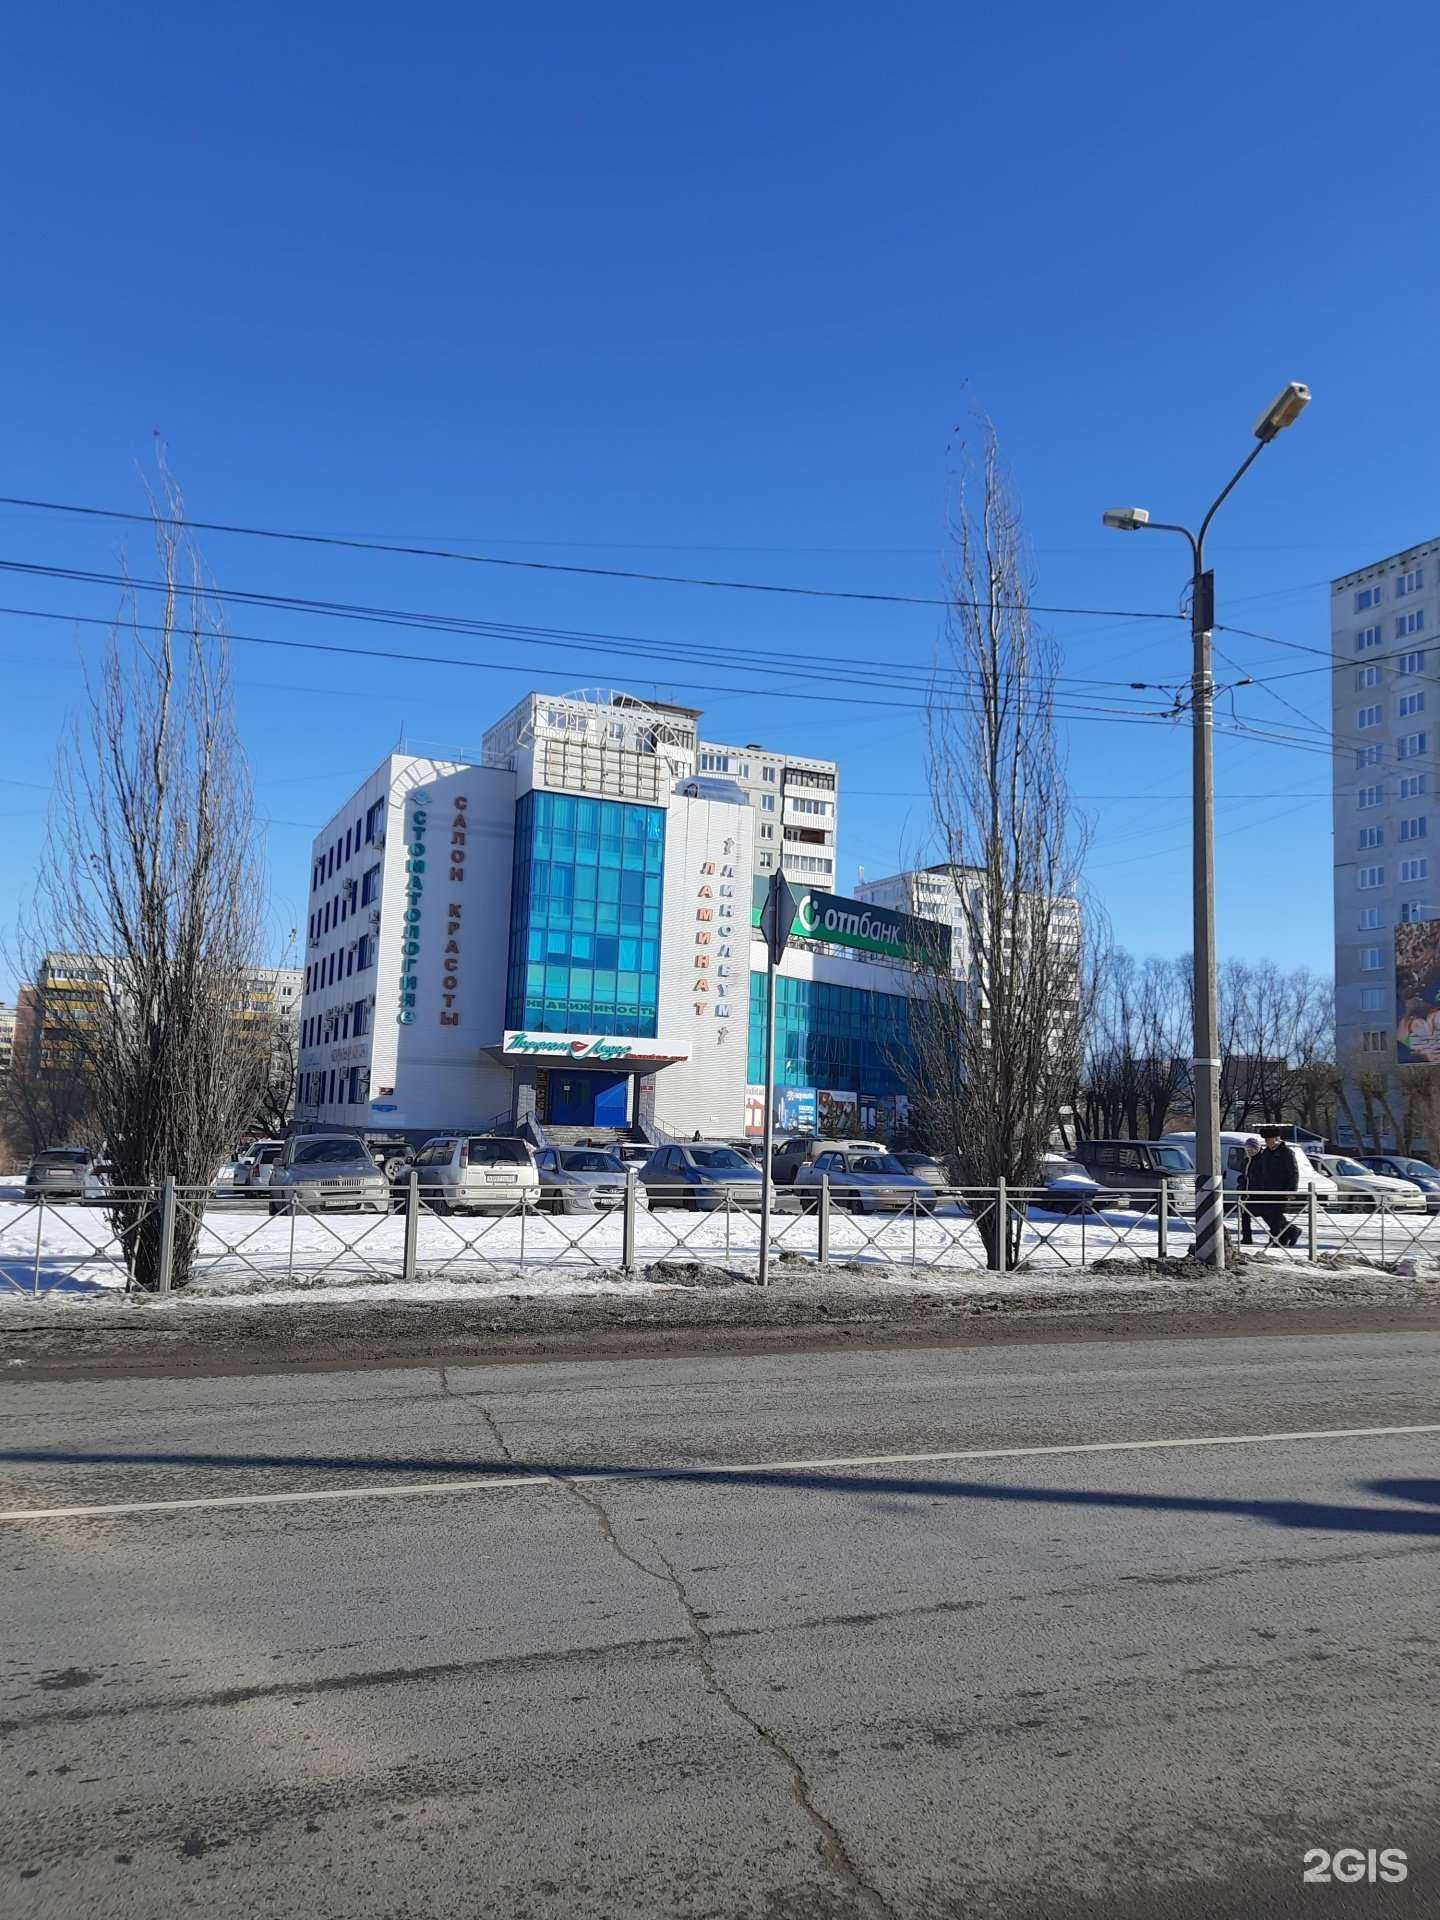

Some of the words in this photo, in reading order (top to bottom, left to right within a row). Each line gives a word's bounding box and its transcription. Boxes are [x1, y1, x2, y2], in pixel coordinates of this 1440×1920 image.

[449, 796, 468, 882] САЛОН
[399, 810, 427, 1008] СТОМАТОЛОГИЯ
[440, 903, 462, 1026] КРАСОТЫ
[693, 862, 716, 1016] ЛАМИНАТ
[714, 864, 737, 1018] ЛИНОЛЕУМ
[526, 999, 656, 1017] НЕДВИЖИМОСТЬ
